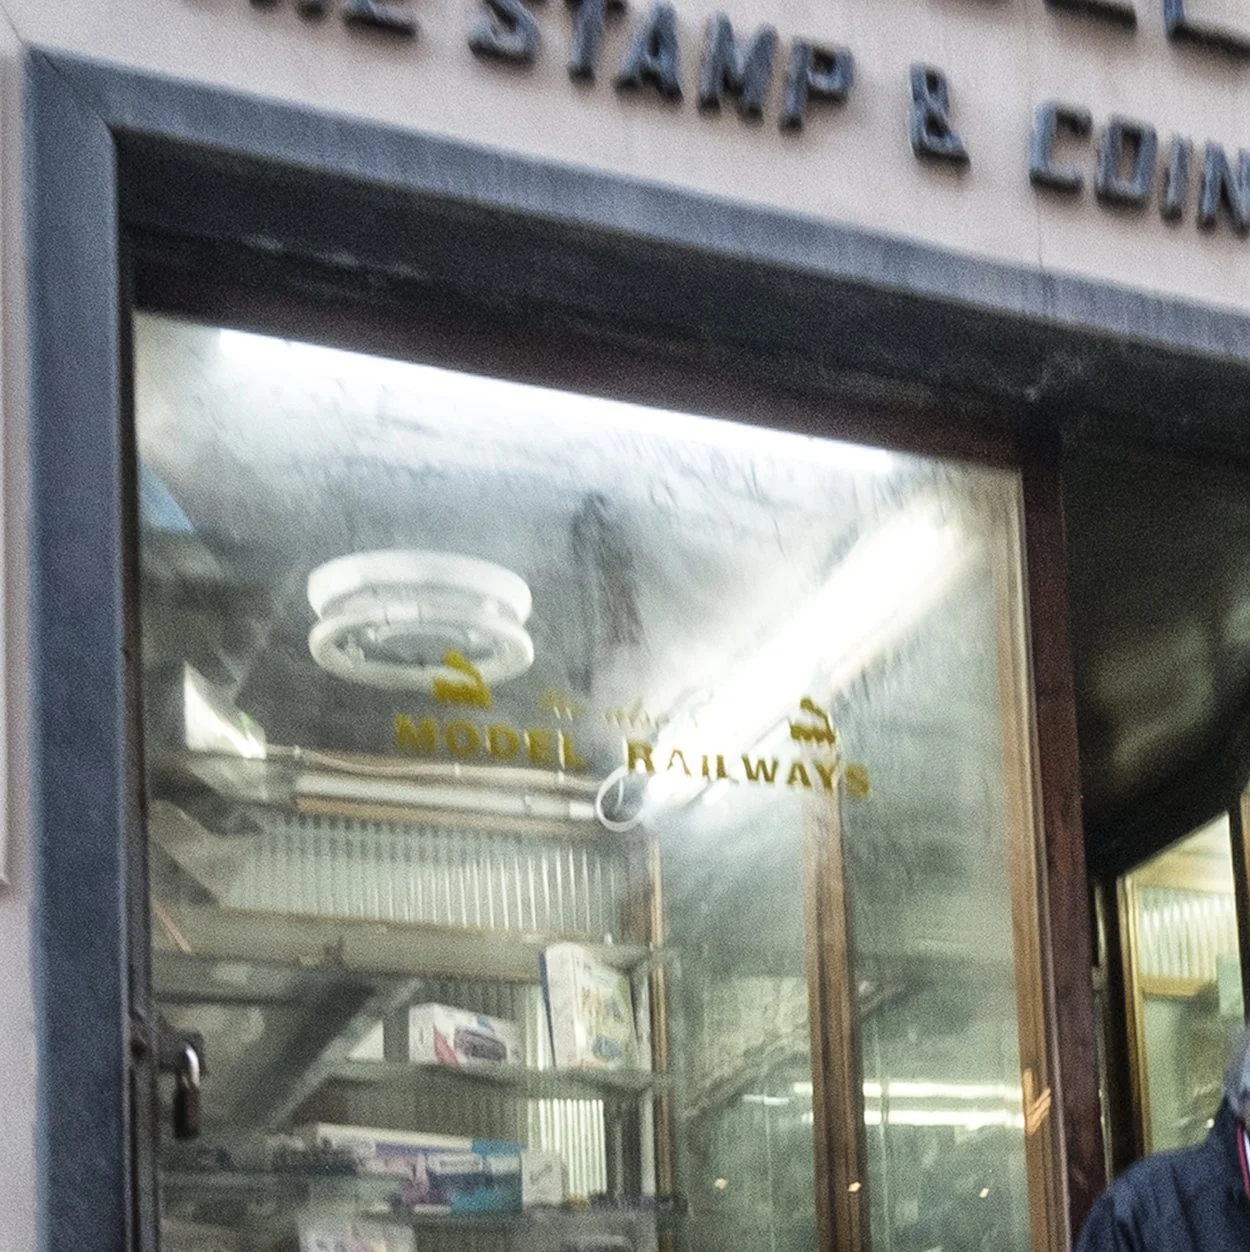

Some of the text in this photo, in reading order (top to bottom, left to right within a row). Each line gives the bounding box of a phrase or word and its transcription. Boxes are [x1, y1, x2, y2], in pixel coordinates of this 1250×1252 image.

[468, 0, 855, 135] STAMP
[910, 61, 971, 170] &
[394, 714, 872, 799] MODEL RAILWAYS
